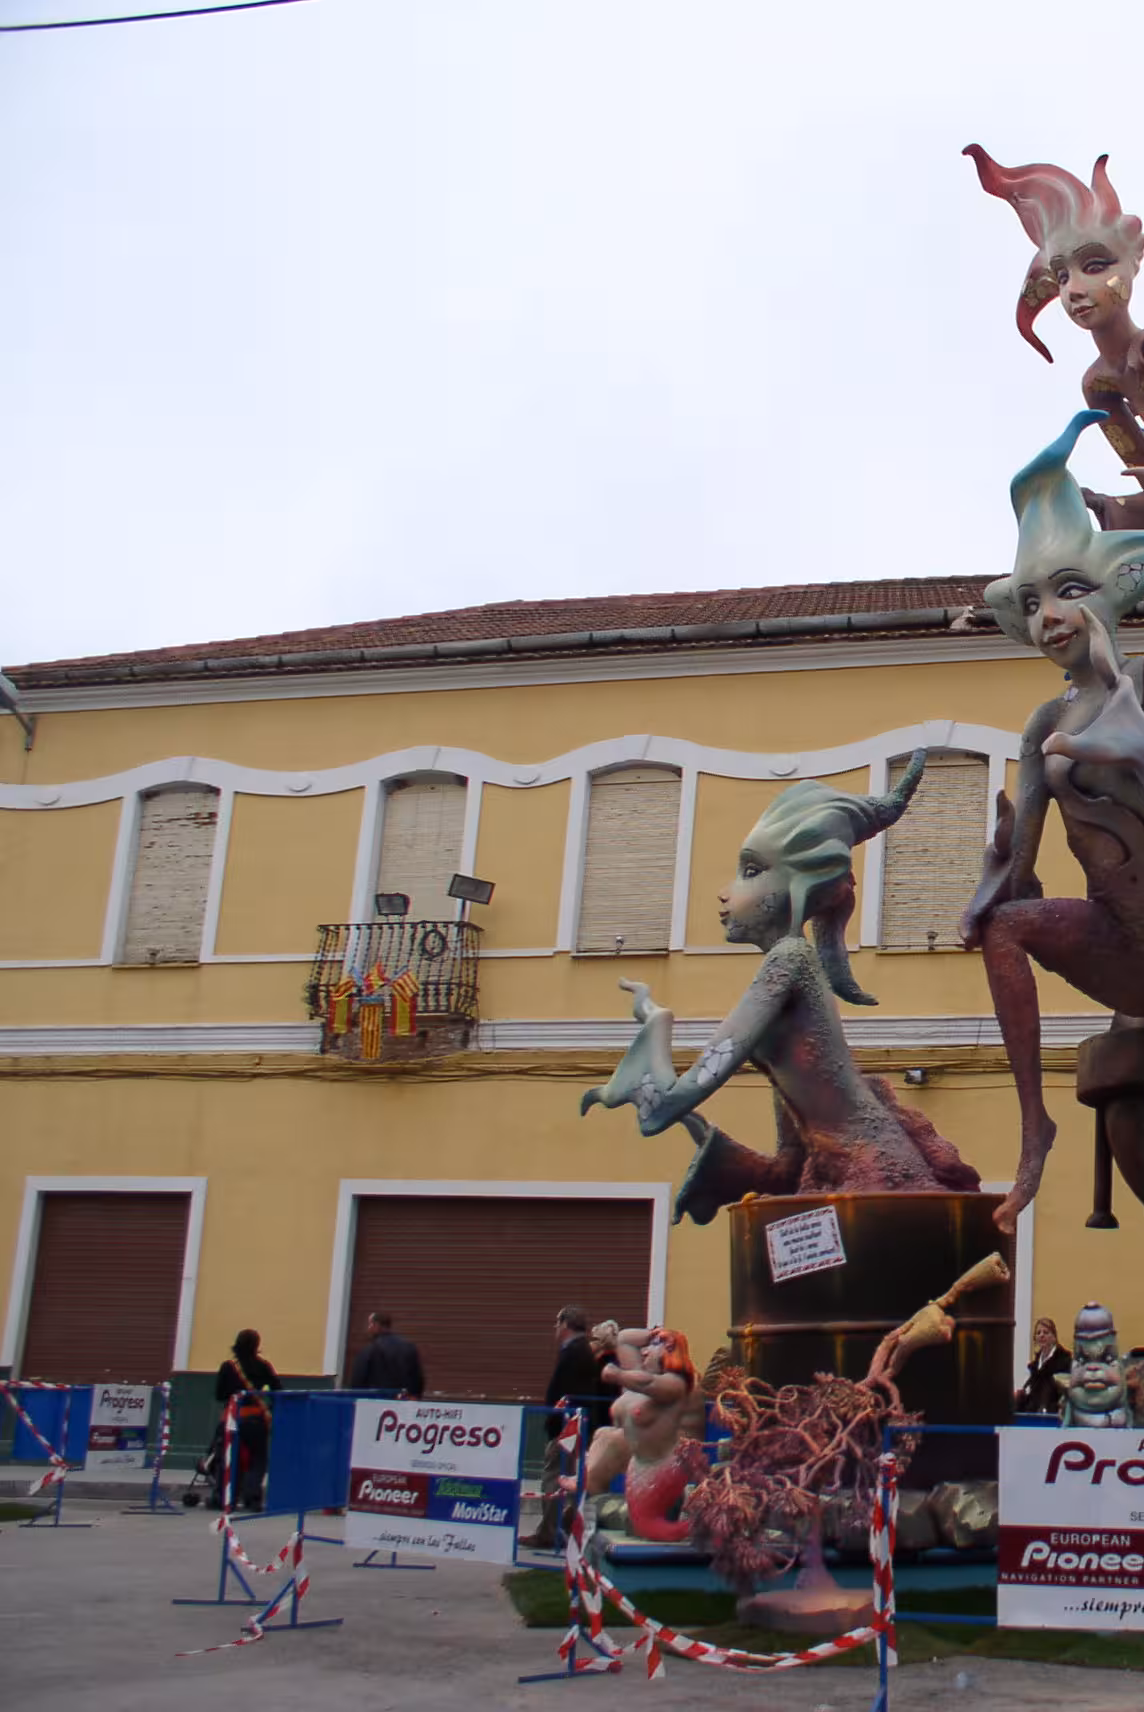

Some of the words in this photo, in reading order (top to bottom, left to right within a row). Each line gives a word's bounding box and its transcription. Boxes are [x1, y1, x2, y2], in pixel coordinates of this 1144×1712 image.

[416, 1408, 463, 1420] AUTO-HIFI
[375, 1410, 502, 1454] Progreso
[358, 1479, 419, 1504] Pioneer
[451, 1501, 509, 1523] MoviStar
[1050, 1533, 1131, 1546] EUROPEAN
[1001, 1573, 1076, 1583] NAVIGATION
[1083, 1575, 1139, 1585] PARTNER
